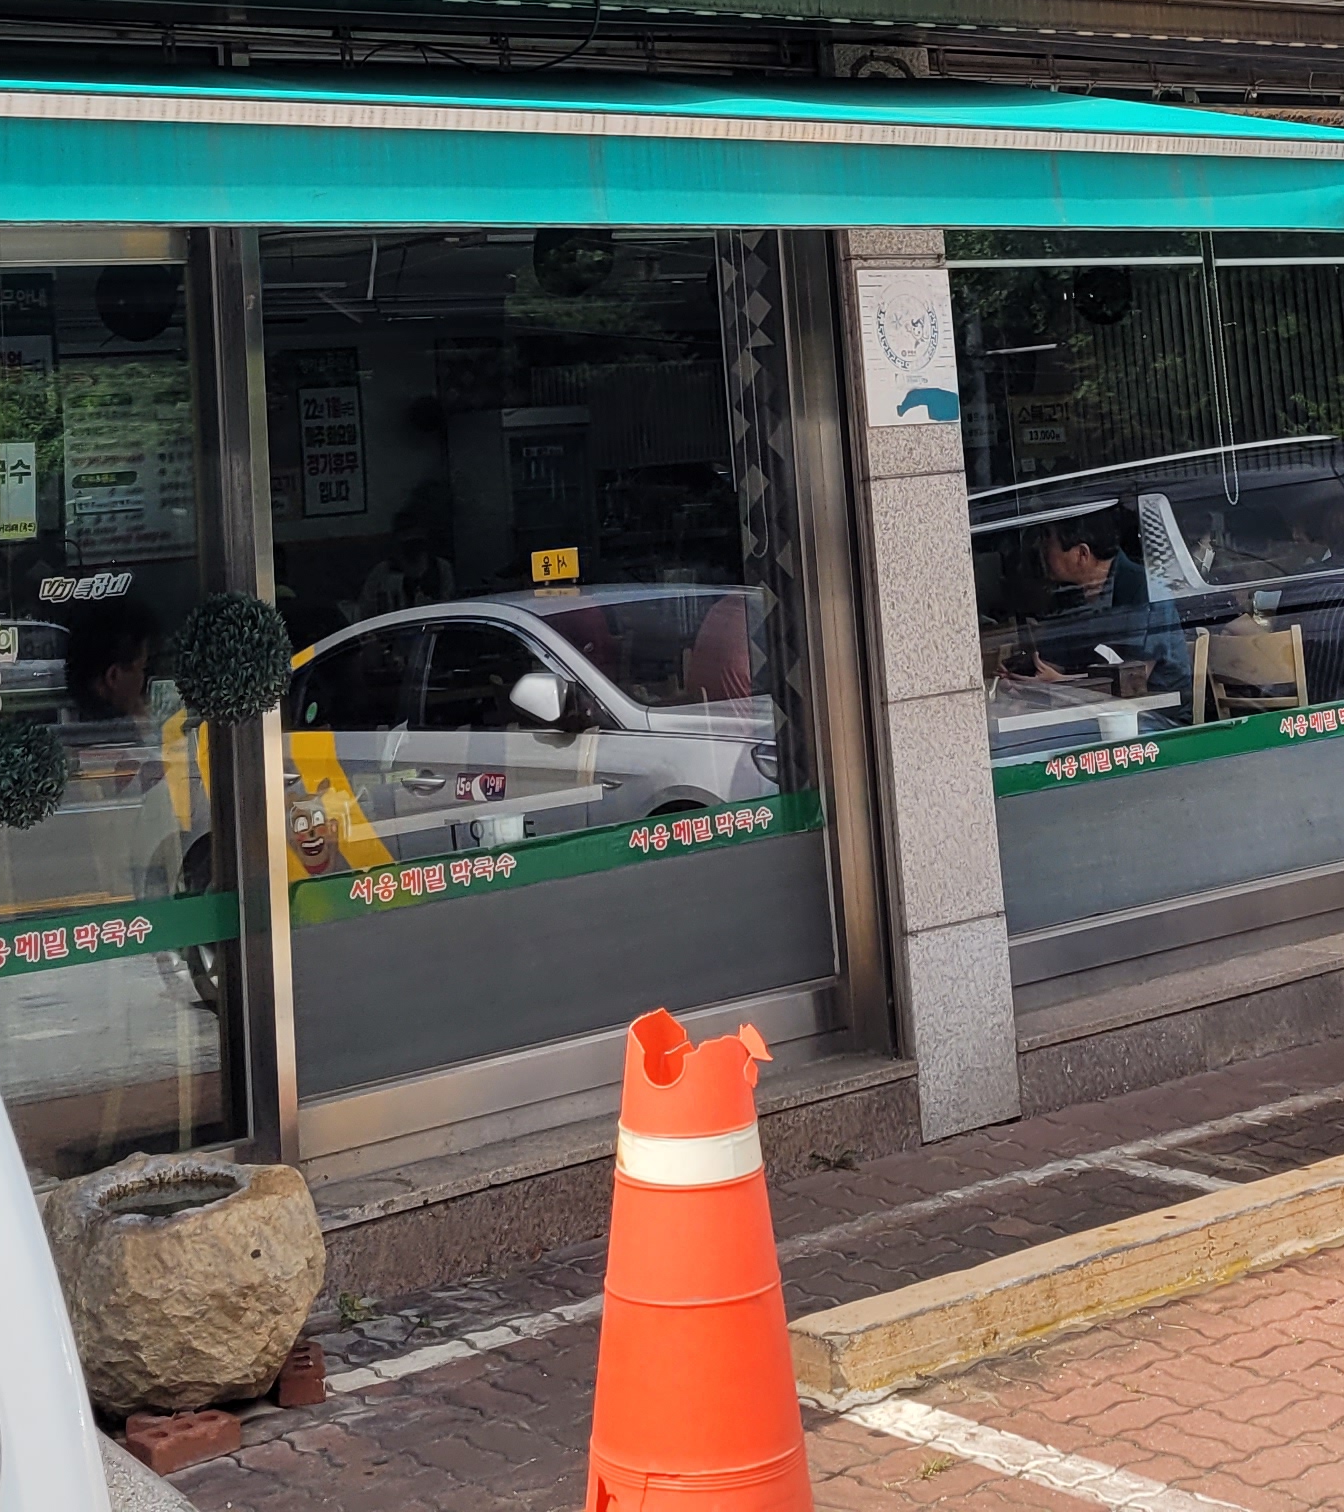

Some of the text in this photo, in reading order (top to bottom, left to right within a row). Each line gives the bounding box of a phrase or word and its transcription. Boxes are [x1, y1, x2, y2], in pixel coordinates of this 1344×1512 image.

[307, 451, 358, 476] 정기휴무
[1114, 742, 1160, 767] 막국수
[715, 806, 774, 836] 막국수
[450, 852, 517, 886] 막국수
[74, 916, 152, 952] 막국수
